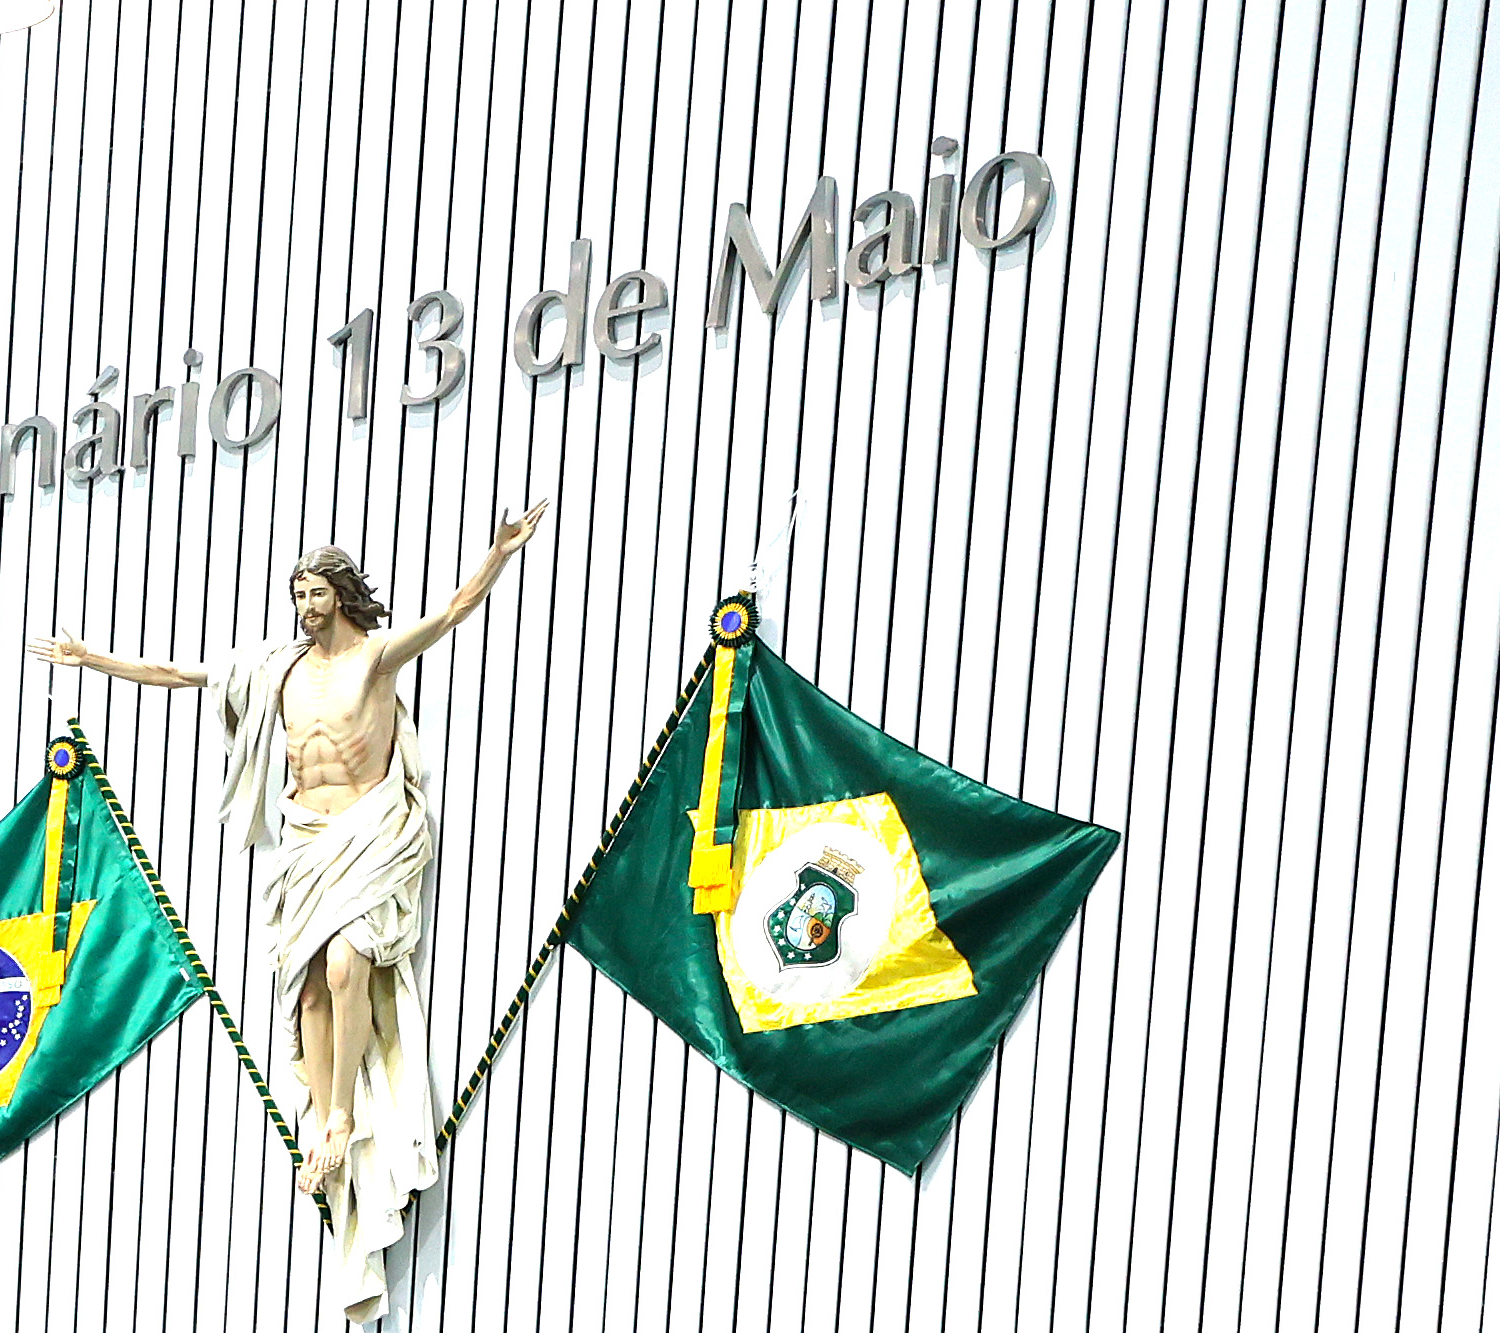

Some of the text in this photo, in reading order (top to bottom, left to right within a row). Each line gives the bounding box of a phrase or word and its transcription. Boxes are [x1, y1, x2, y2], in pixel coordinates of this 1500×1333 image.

[326, 288, 465, 420] 13
[513, 237, 669, 379] de
[706, 135, 1057, 331] Maio
